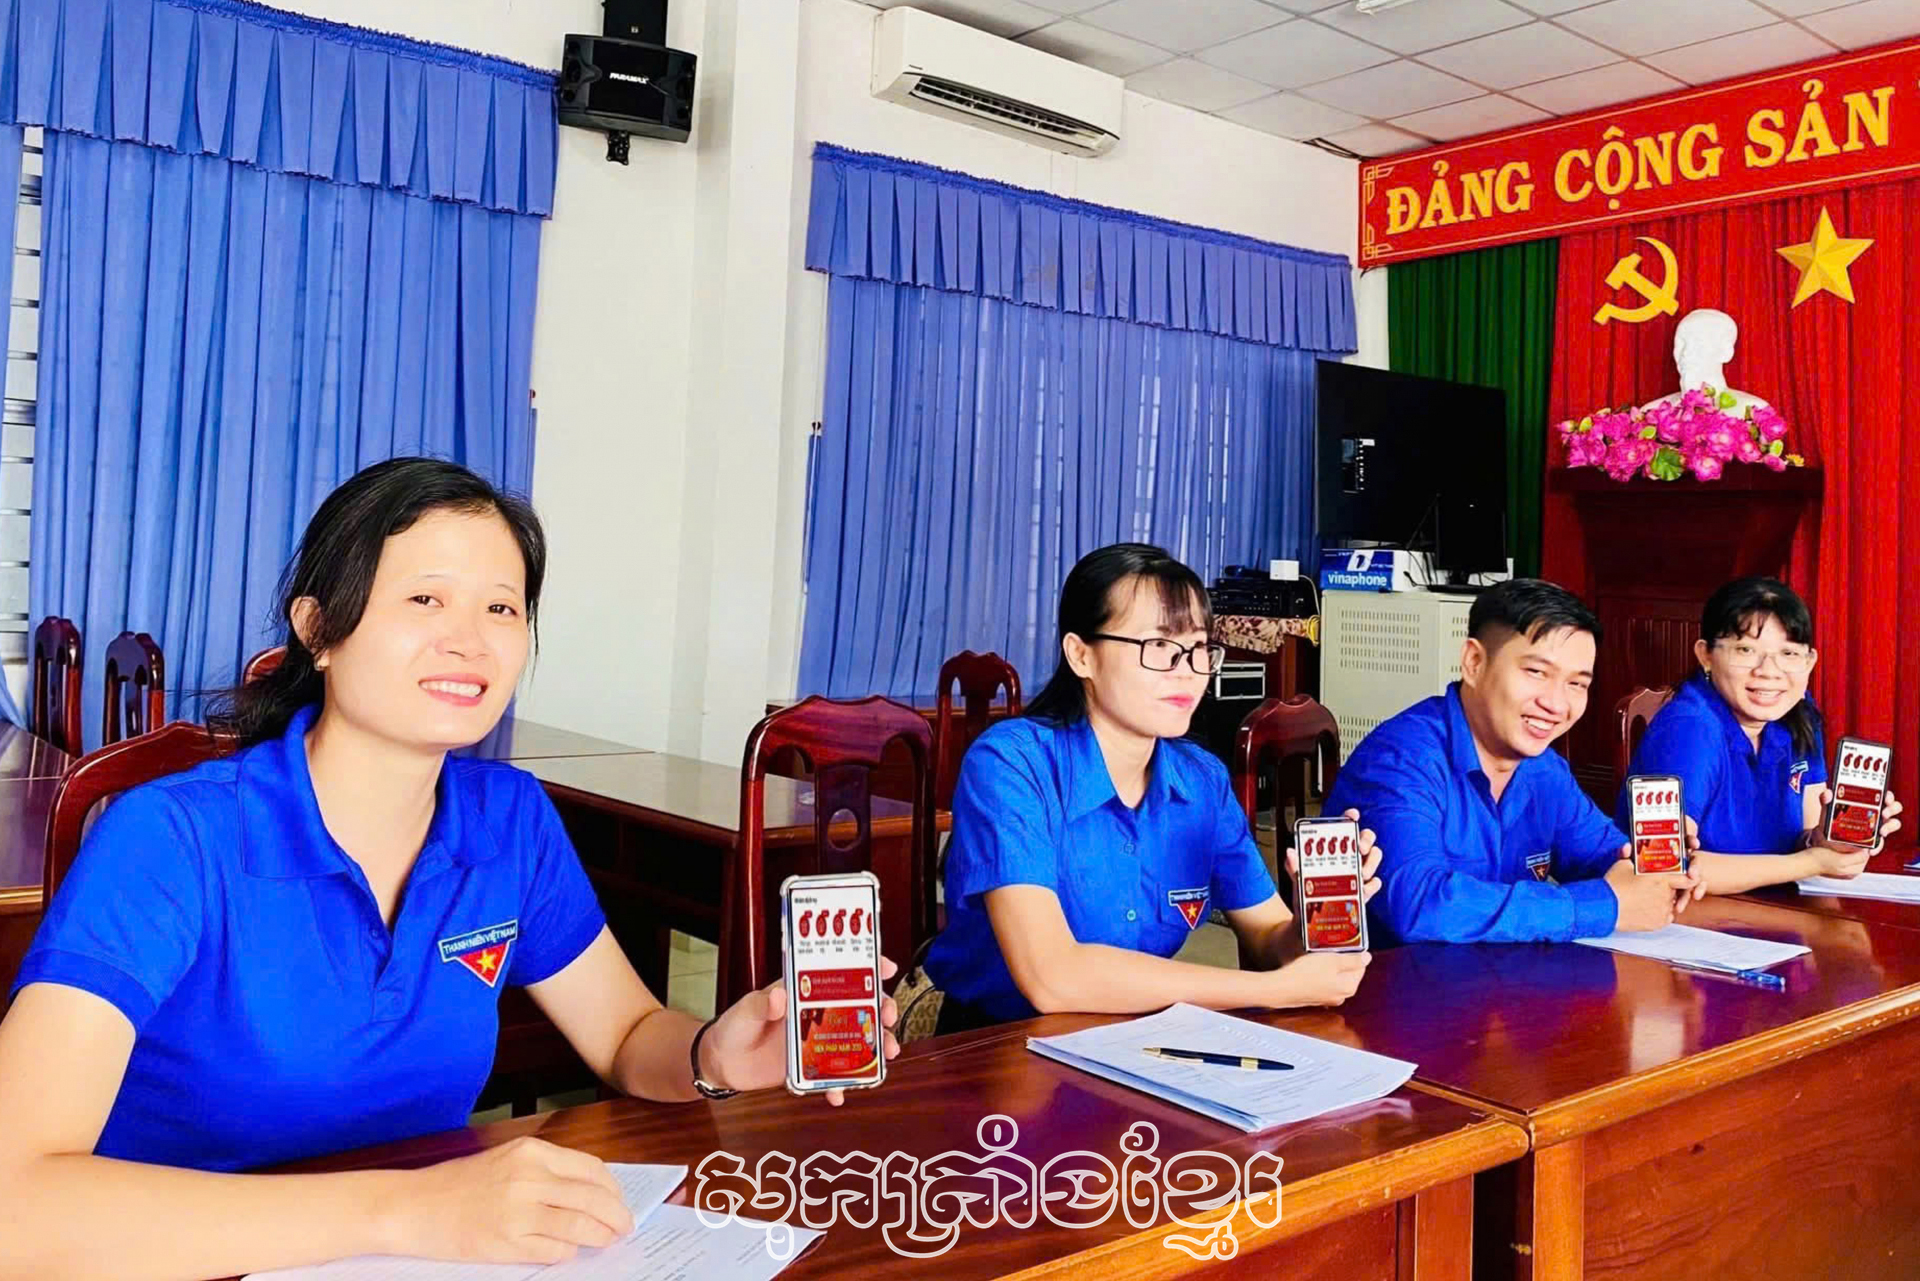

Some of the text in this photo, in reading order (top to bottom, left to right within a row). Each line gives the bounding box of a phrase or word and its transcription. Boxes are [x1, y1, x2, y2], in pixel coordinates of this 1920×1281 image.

[609, 72, 648, 84] PARAMAX
[1386, 79, 1896, 235] ĐẢNG CỘNG SẢN
[1328, 571, 1387, 587] vinaphone
